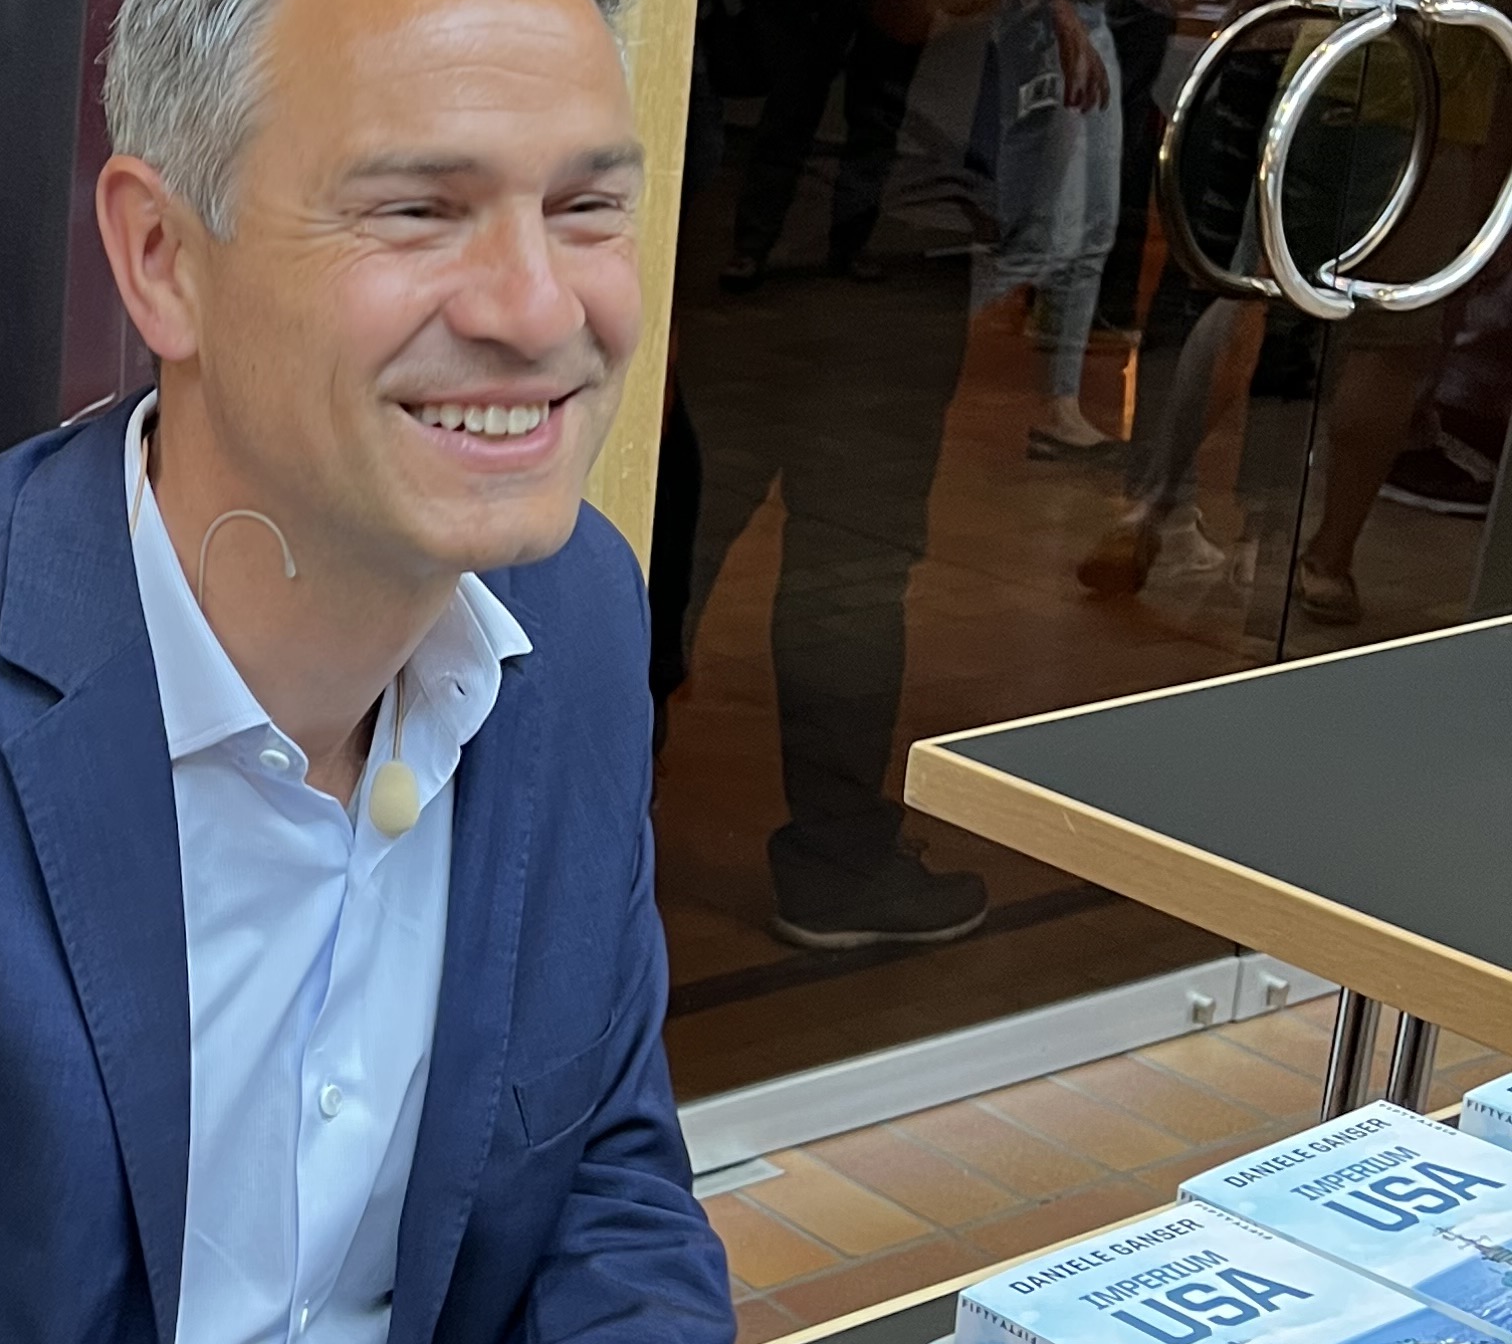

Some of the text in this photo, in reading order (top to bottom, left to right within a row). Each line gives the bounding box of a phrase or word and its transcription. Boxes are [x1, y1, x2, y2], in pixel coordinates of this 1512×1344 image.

[1223, 1118, 1392, 1188] DANIELE GANSER
[1290, 1145, 1421, 1201] IMPERIUM
[1322, 1161, 1506, 1233] USA
[1009, 1218, 1205, 1294] DANIELE GANSER
[1078, 1249, 1230, 1310] IMPERIUM
